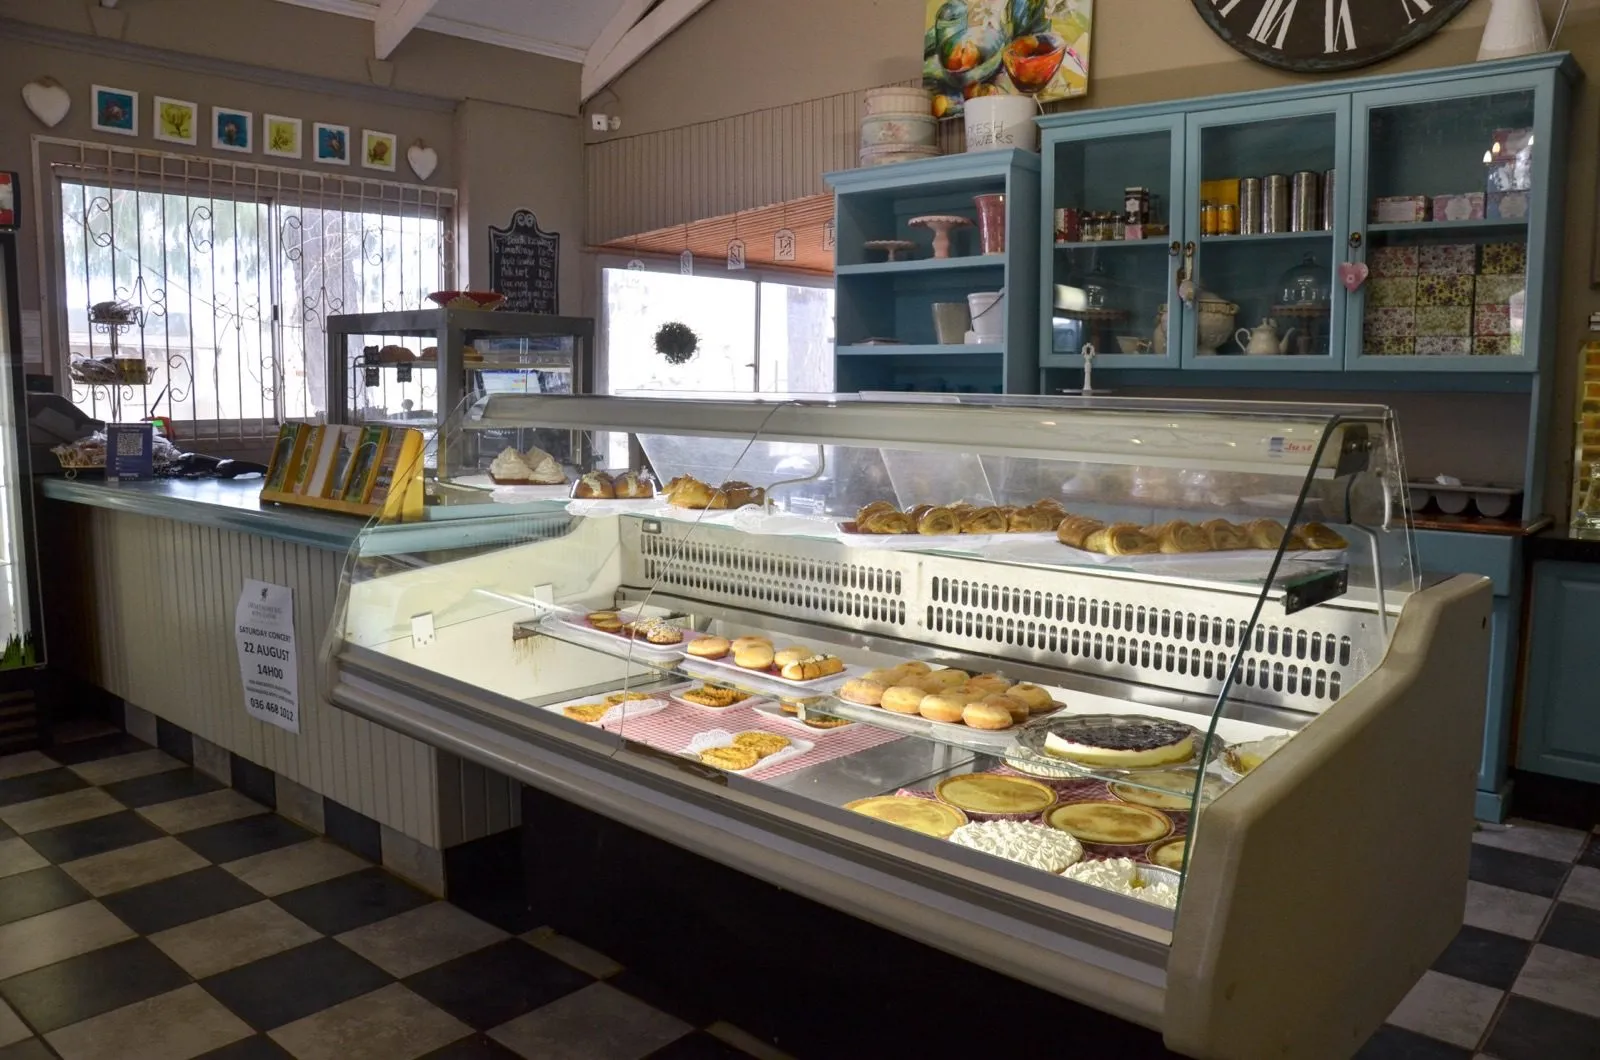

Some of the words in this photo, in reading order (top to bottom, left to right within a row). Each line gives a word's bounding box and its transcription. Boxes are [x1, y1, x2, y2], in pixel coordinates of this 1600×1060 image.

[967, 119, 1004, 136] RESH
[967, 131, 1014, 147] OWERS
[239, 625, 268, 637] SATURDAY
[268, 631, 291, 642] CONCERT
[243, 641, 255, 654] 22
[257, 643, 289, 662] AUGUST
[257, 663, 284, 680] 14H00
[250, 697, 265, 710] 036
[266, 701, 279, 714] 468
